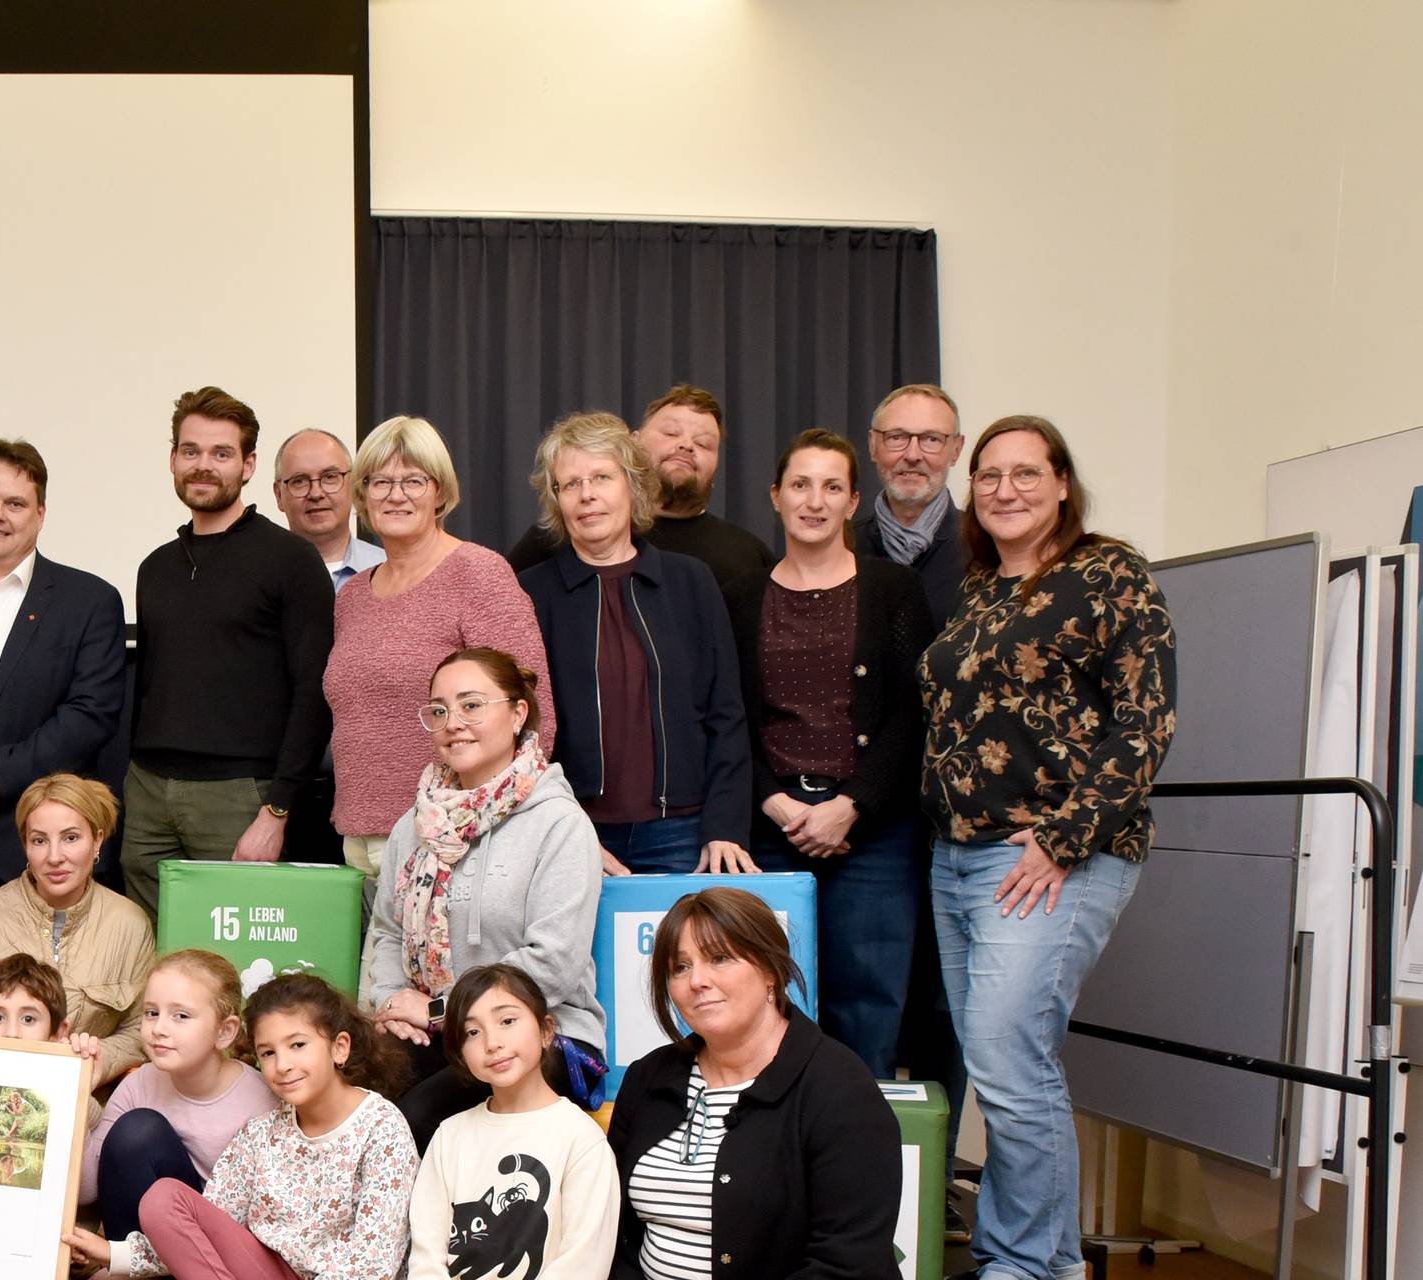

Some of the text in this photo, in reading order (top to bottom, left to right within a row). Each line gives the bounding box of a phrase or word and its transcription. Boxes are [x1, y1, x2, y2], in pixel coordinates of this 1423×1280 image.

[210, 906, 240, 942] 15
[248, 906, 285, 923] LEBEN
[248, 925, 298, 943] AN LAND
[637, 922, 655, 955] 6
